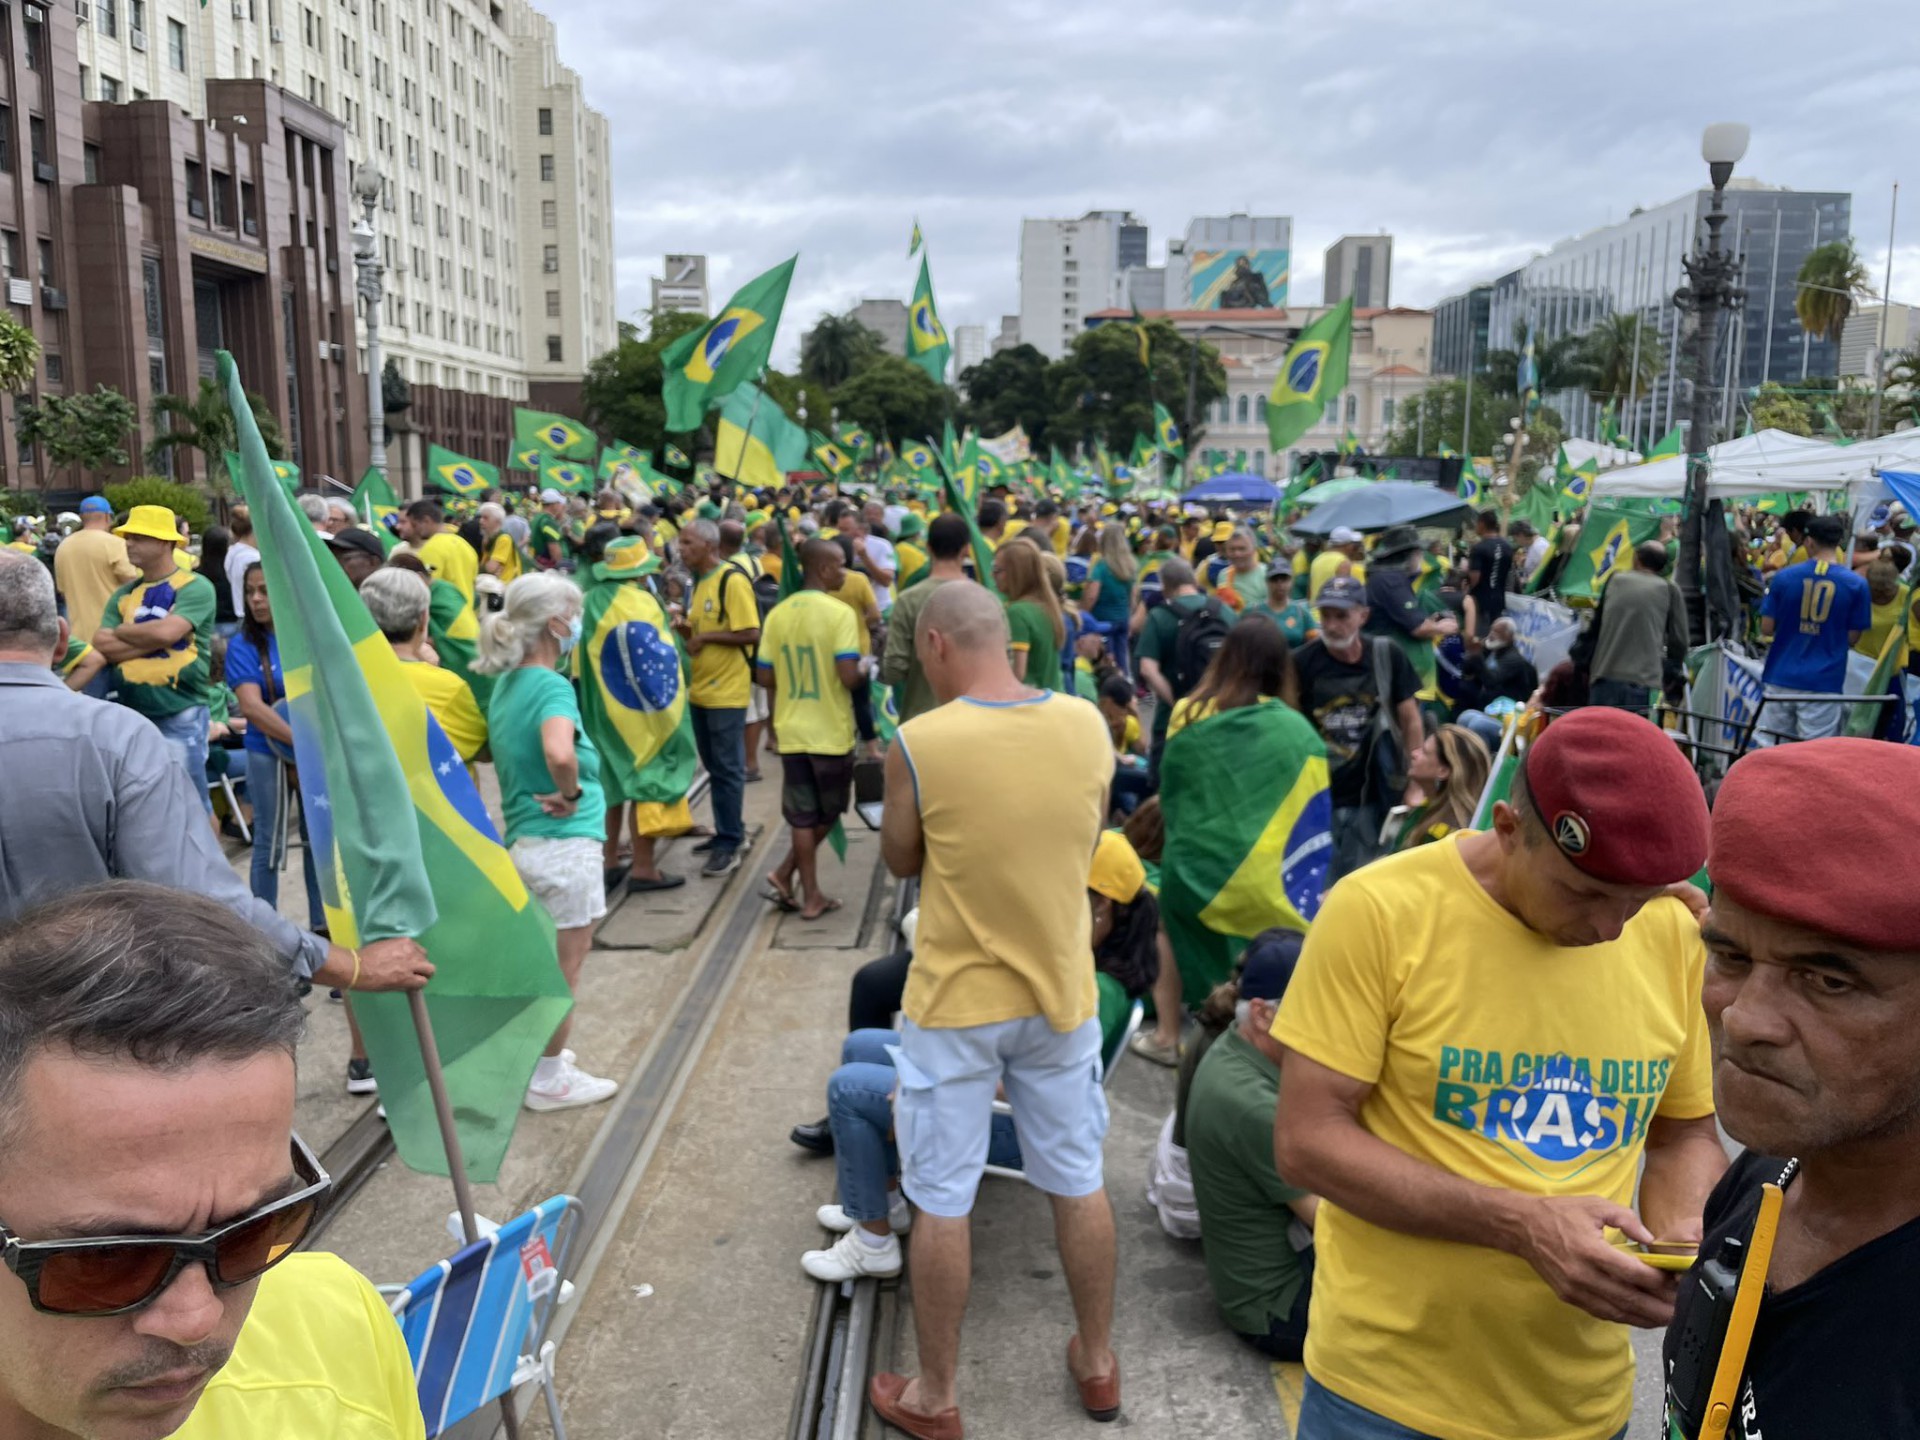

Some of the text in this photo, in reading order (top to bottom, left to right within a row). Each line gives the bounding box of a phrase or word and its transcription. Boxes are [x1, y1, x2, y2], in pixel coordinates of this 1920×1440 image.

[1801, 578, 1836, 623] 10
[781, 644, 820, 700] 10
[1440, 1046, 1670, 1094] PRA CIMA DELES
